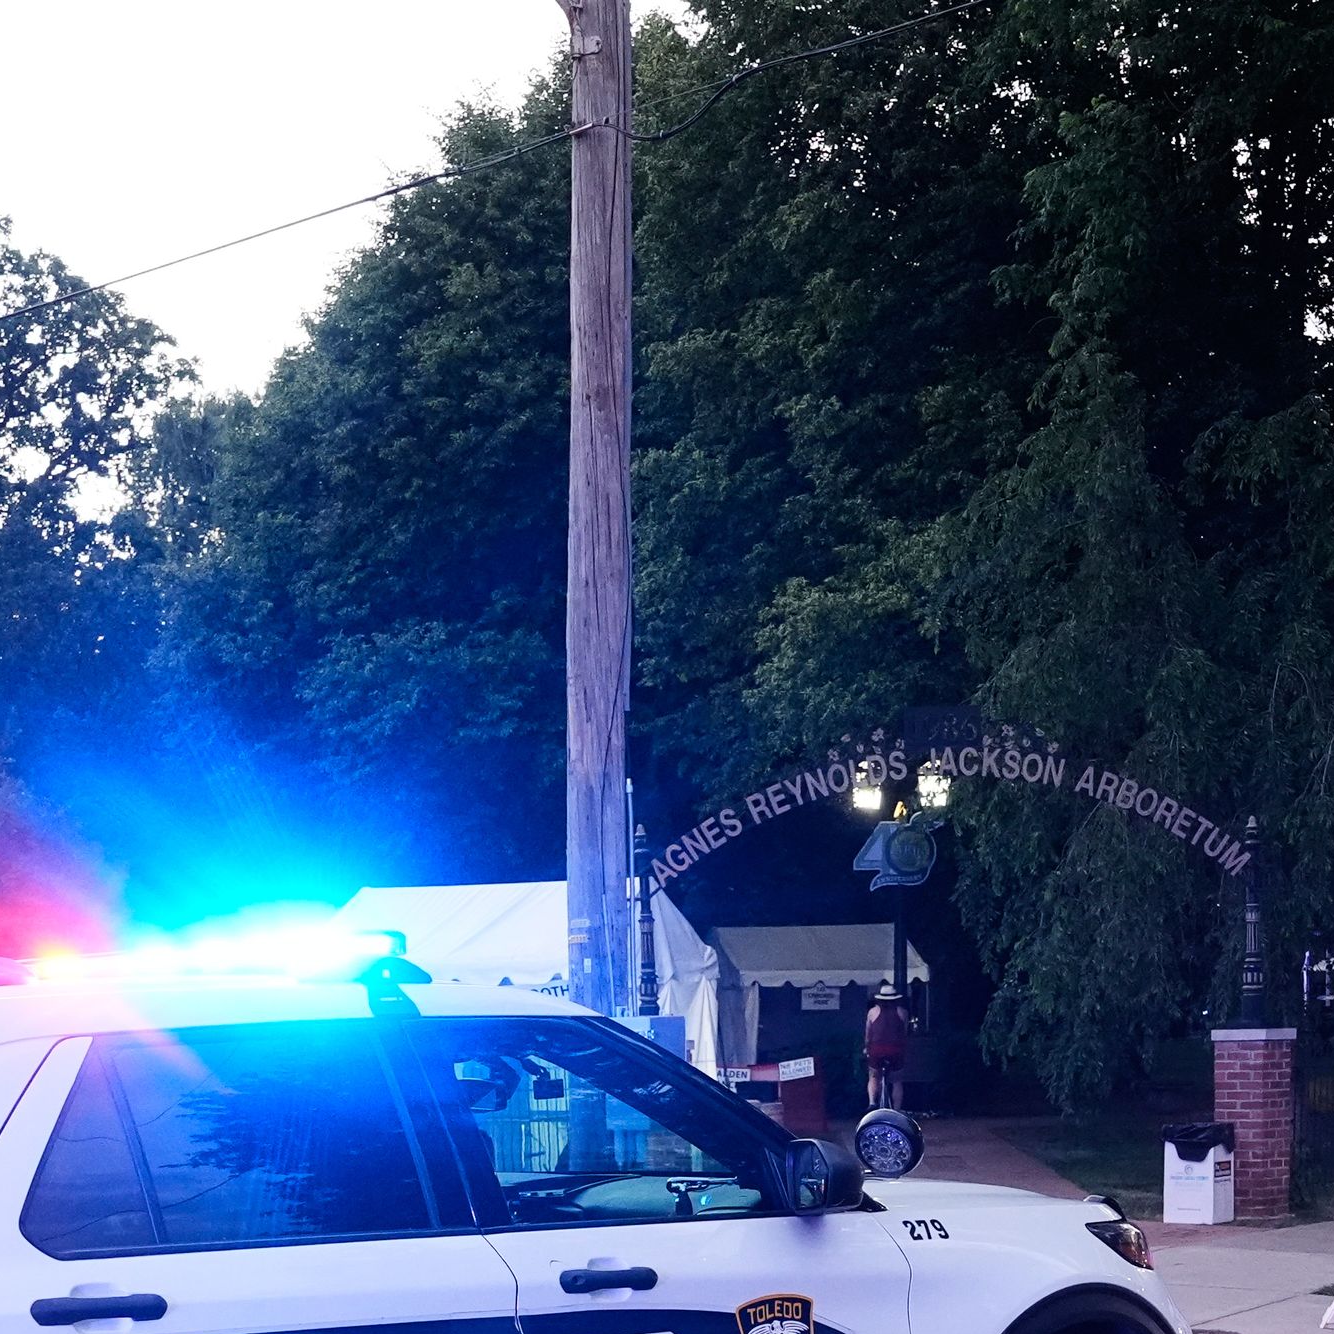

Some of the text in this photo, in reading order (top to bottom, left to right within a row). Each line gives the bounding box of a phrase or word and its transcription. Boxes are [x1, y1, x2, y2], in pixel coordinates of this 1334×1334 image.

[651, 747, 1252, 889] AGNES REYNOLDS JACKSON ARBORETUM
[902, 1219, 950, 1241] 279
[747, 1300, 802, 1326] TOLEDO
